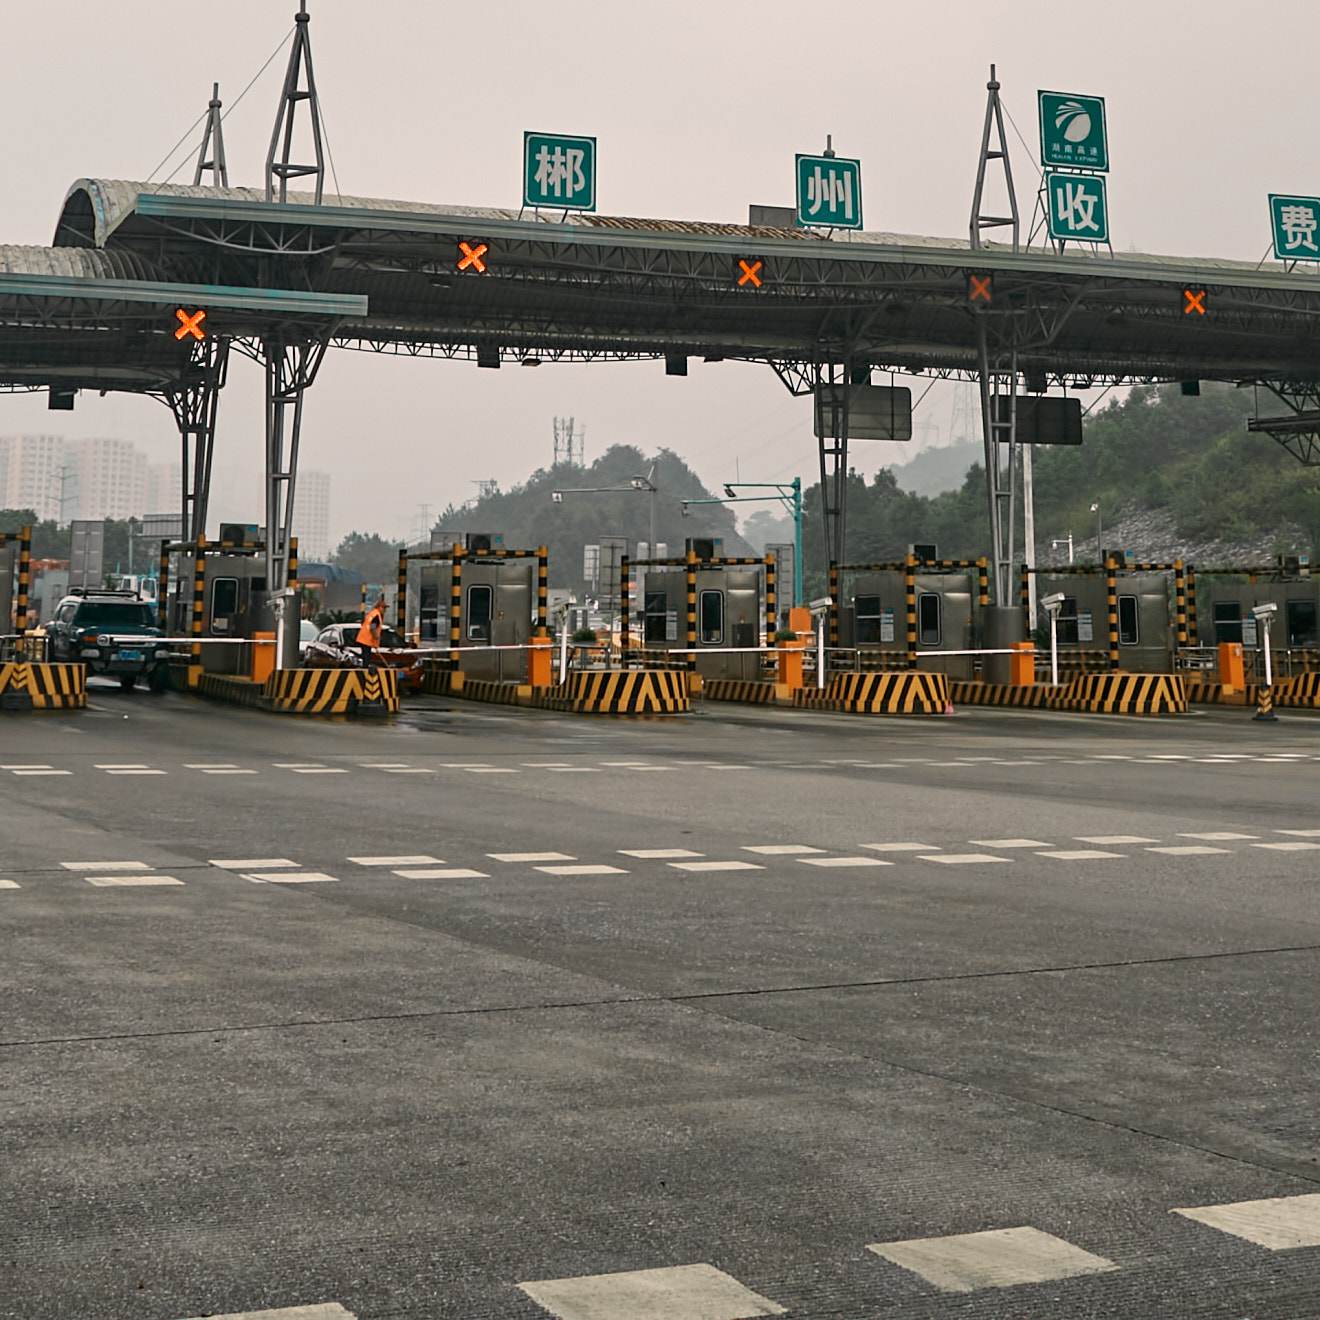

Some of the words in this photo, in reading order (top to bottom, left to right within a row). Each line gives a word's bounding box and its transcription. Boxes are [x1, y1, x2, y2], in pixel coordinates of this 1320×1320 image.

[534, 145, 585, 198] 郴
[807, 166, 852, 219] 州
[1057, 182, 1099, 232] 收
[1281, 205, 1318, 251] 费
